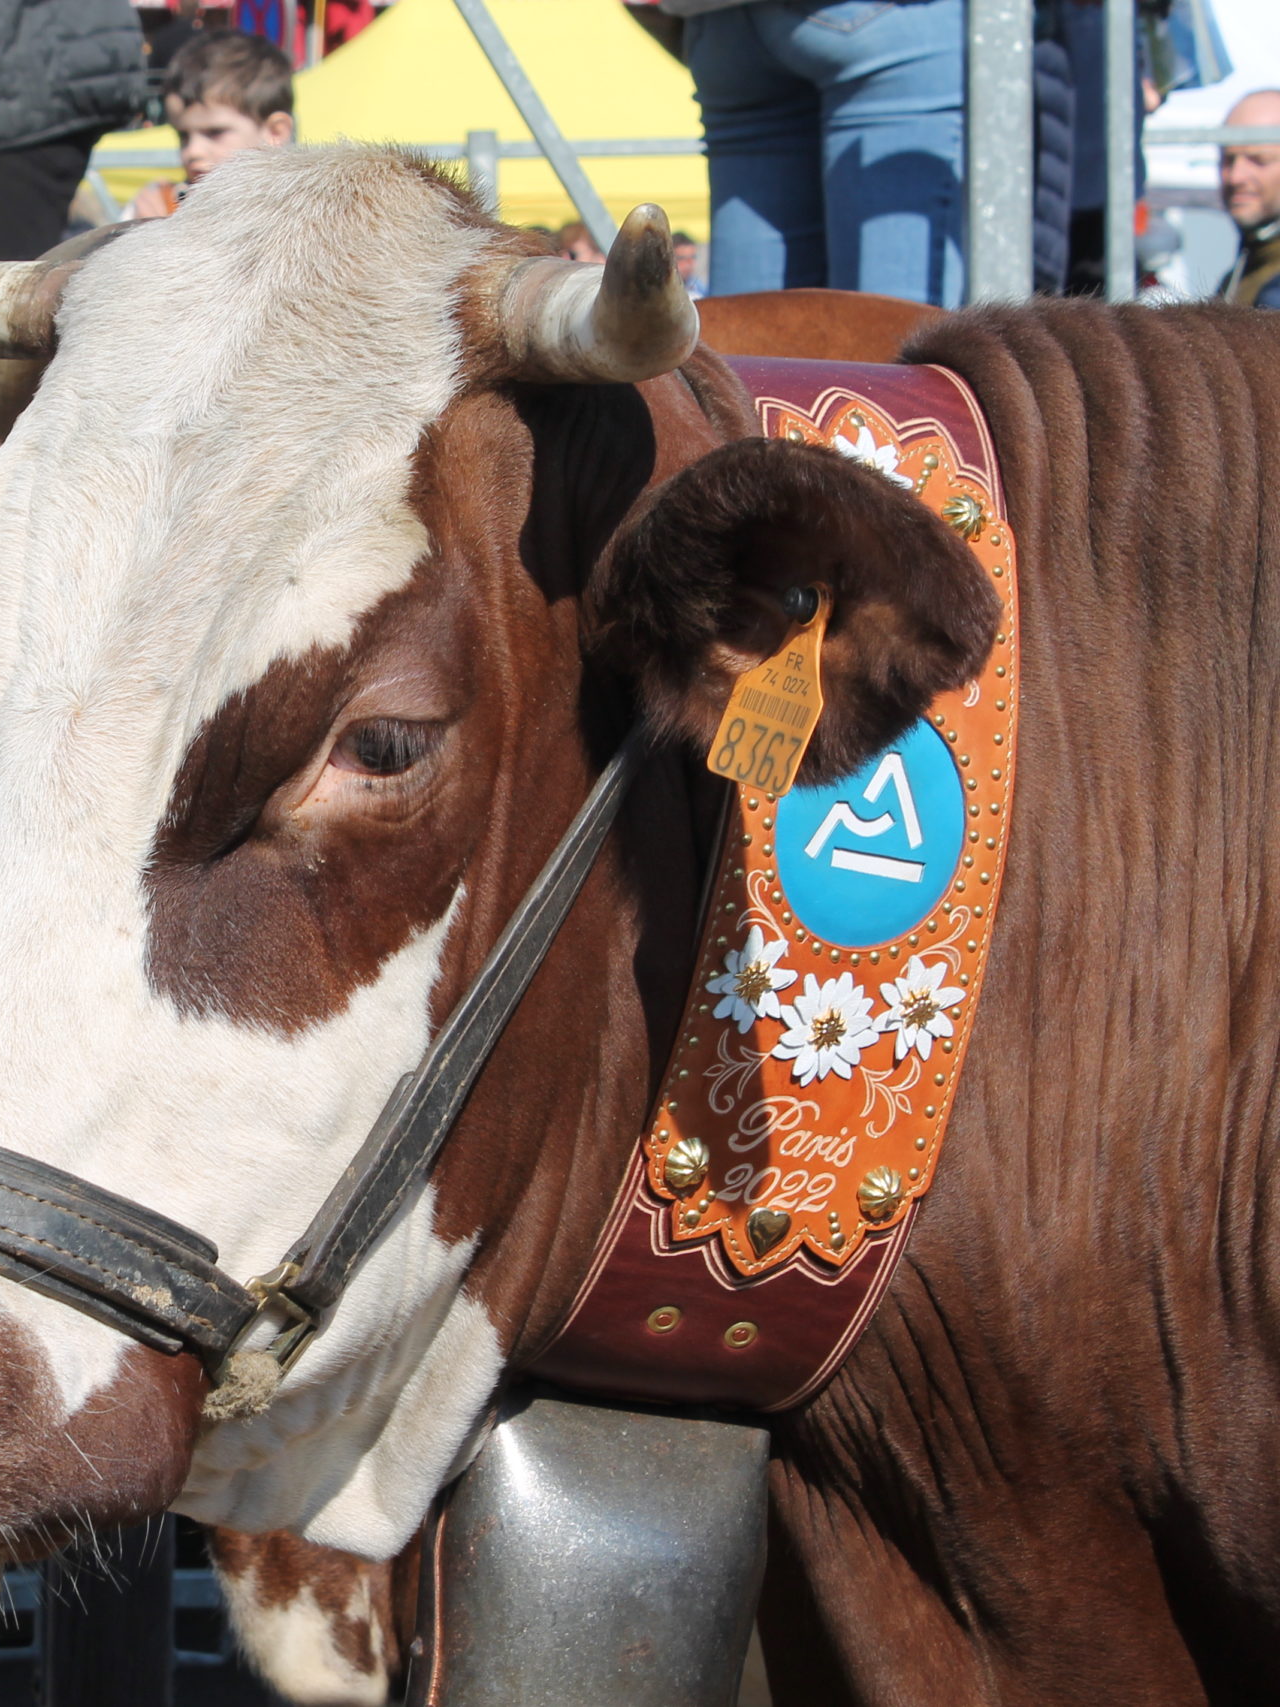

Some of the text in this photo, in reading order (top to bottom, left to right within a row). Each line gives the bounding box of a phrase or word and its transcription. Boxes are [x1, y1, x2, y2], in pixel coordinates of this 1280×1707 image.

[760, 667, 812, 697] 74 0274
[784, 651, 805, 672] FR
[713, 717, 805, 792] 8363
[727, 1095, 858, 1168] Paris
[715, 1163, 837, 1213] 2022
